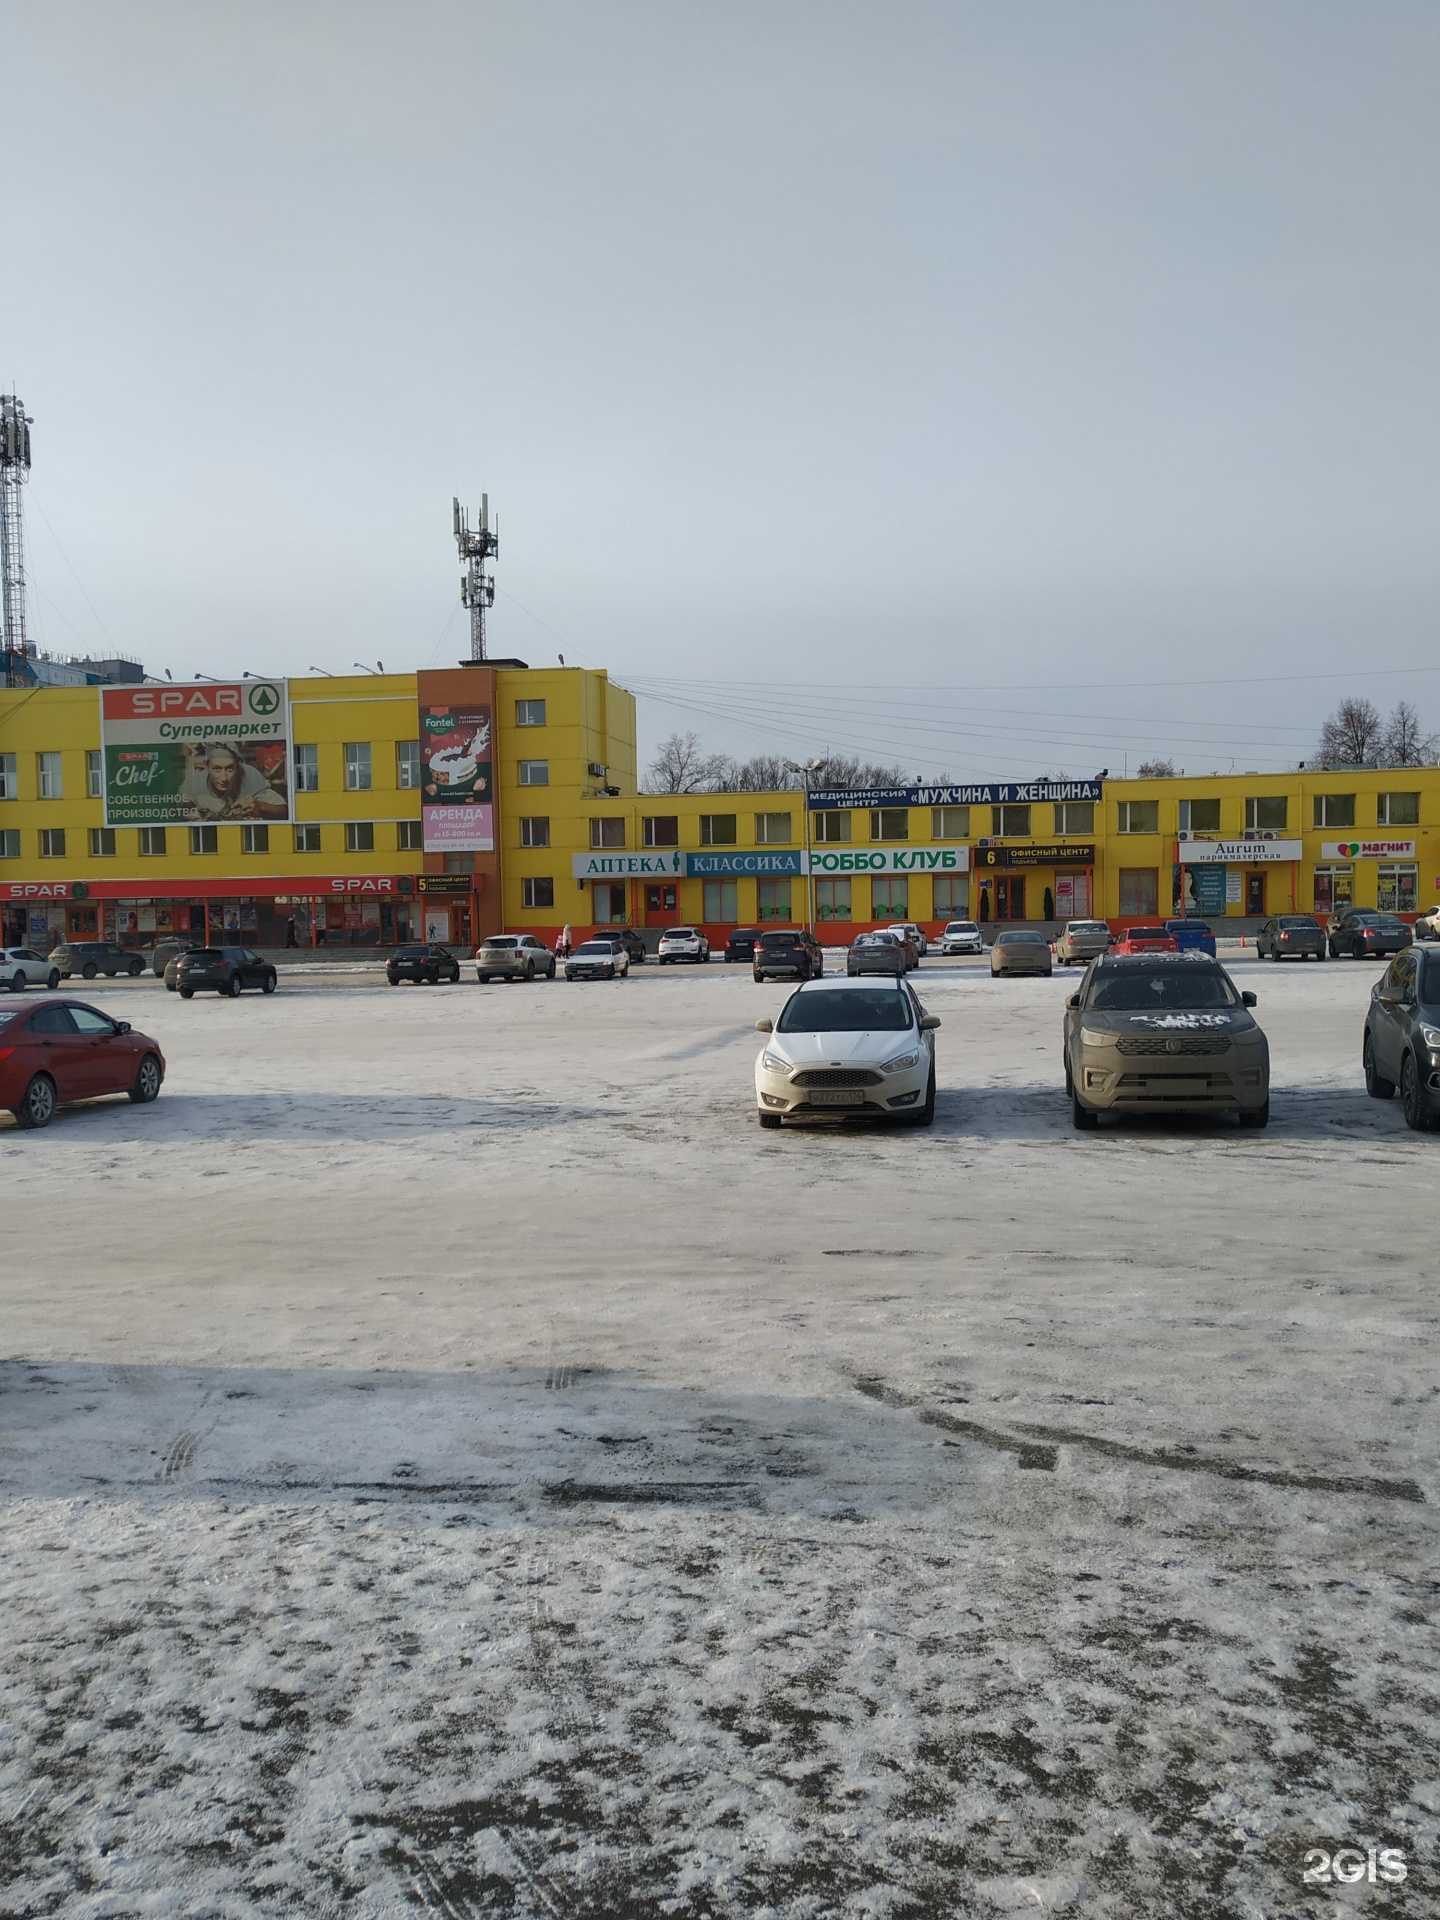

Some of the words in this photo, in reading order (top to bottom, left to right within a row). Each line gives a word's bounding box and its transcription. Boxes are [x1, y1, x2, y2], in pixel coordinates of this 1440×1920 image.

[132, 689, 240, 713] SPAR
[159, 722, 282, 740] Супермаркет
[114, 761, 161, 787] Chef
[108, 793, 189, 805] СОБСТВЕННОЕ
[809, 789, 907, 801] МЕДИЦИНСКИЙ
[911, 786, 992, 804] «МУЖЧИНА
[999, 786, 1009, 801] И
[1016, 783, 1099, 801] ЖЕНЩИНА»
[837, 798, 880, 807] ЦЕНТР
[108, 807, 198, 818] ПРОИЗВОДСТВО
[430, 808, 483, 821] АРЕНДА
[1010, 847, 1058, 857] ОФИСНЫЙ
[1060, 847, 1090, 857] ЦЕНТР
[1215, 843, 1266, 854] Aurum
[810, 853, 886, 871] РОББО
[892, 850, 957, 869] КЛУБ
[986, 850, 996, 864] 6
[1200, 852, 1281, 862] парикмахерская
[586, 857, 667, 873] АПТЕКА
[692, 855, 797, 873] КЛАССИКА
[10, 884, 67, 897] SPAR
[331, 878, 392, 891] SPAR
[418, 878, 427, 891] 5
